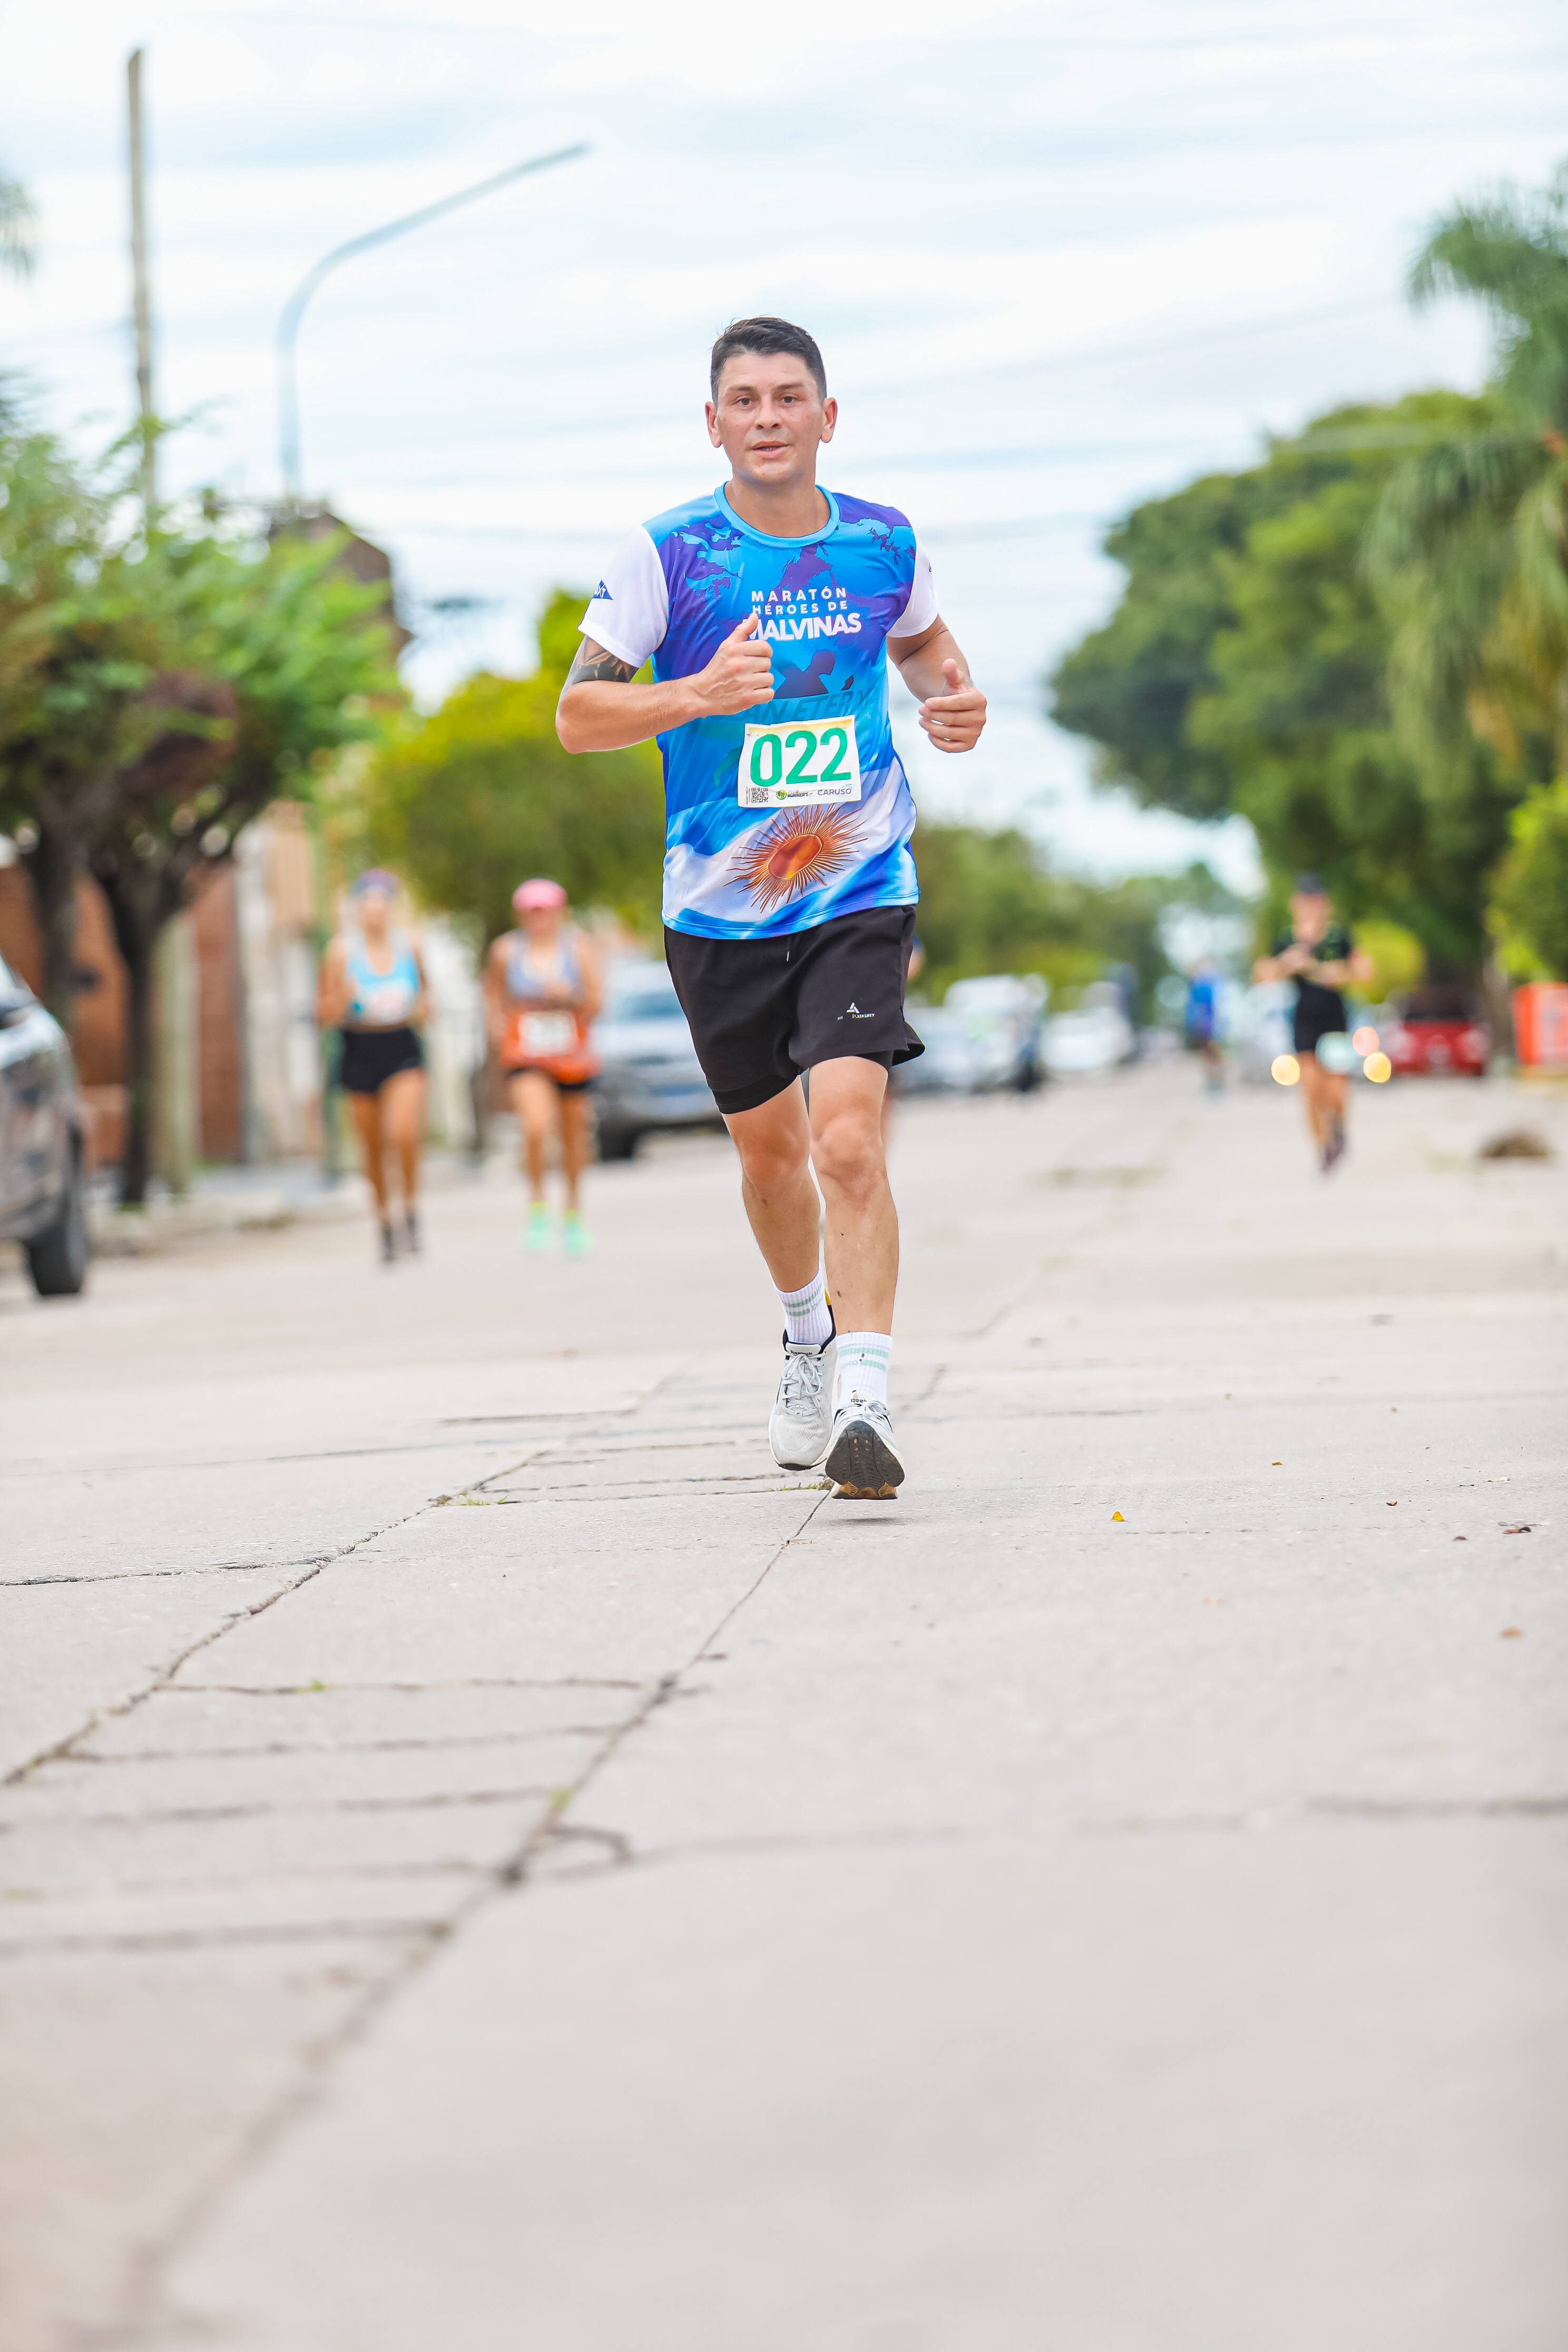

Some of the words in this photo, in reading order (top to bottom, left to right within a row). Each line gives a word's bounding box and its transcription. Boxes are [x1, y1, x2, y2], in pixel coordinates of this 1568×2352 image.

[751, 585, 847, 602] MARATÓN
[752, 603, 819, 615] HÉROES
[828, 600, 848, 612] DE
[750, 727, 851, 787] 022
